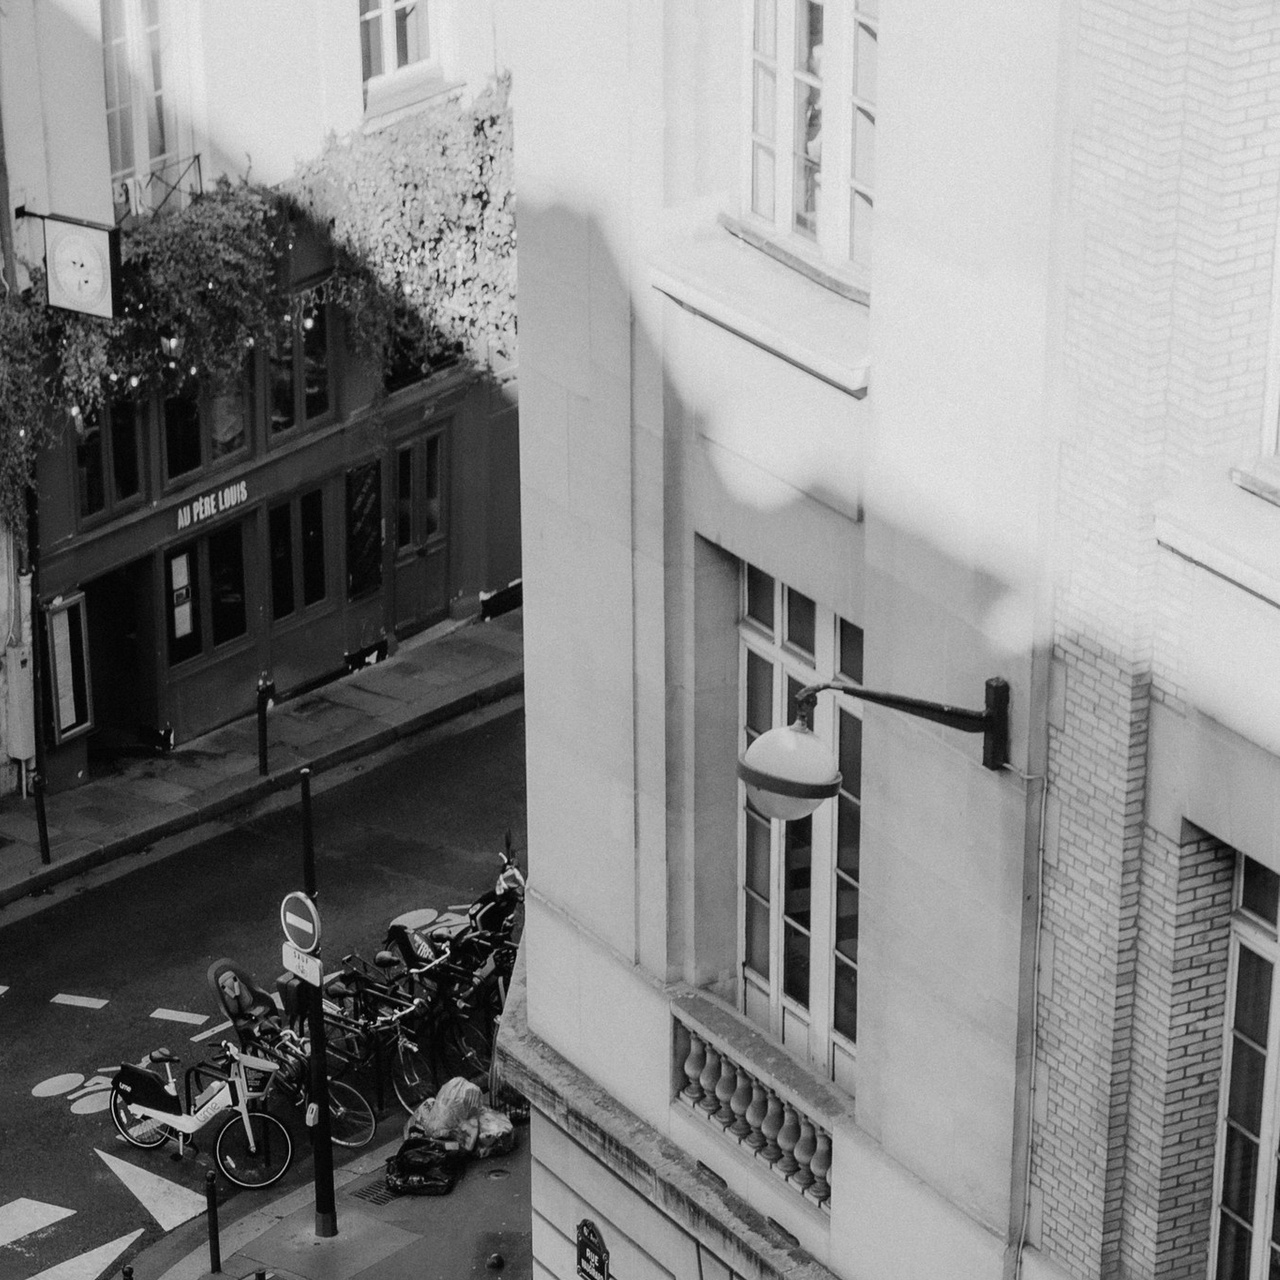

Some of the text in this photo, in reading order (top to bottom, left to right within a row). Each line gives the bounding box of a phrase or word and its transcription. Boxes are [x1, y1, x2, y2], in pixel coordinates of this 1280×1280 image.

[177, 480, 247, 530] AU PÈRE LOUIS
[586, 1247, 600, 1267] RUE
